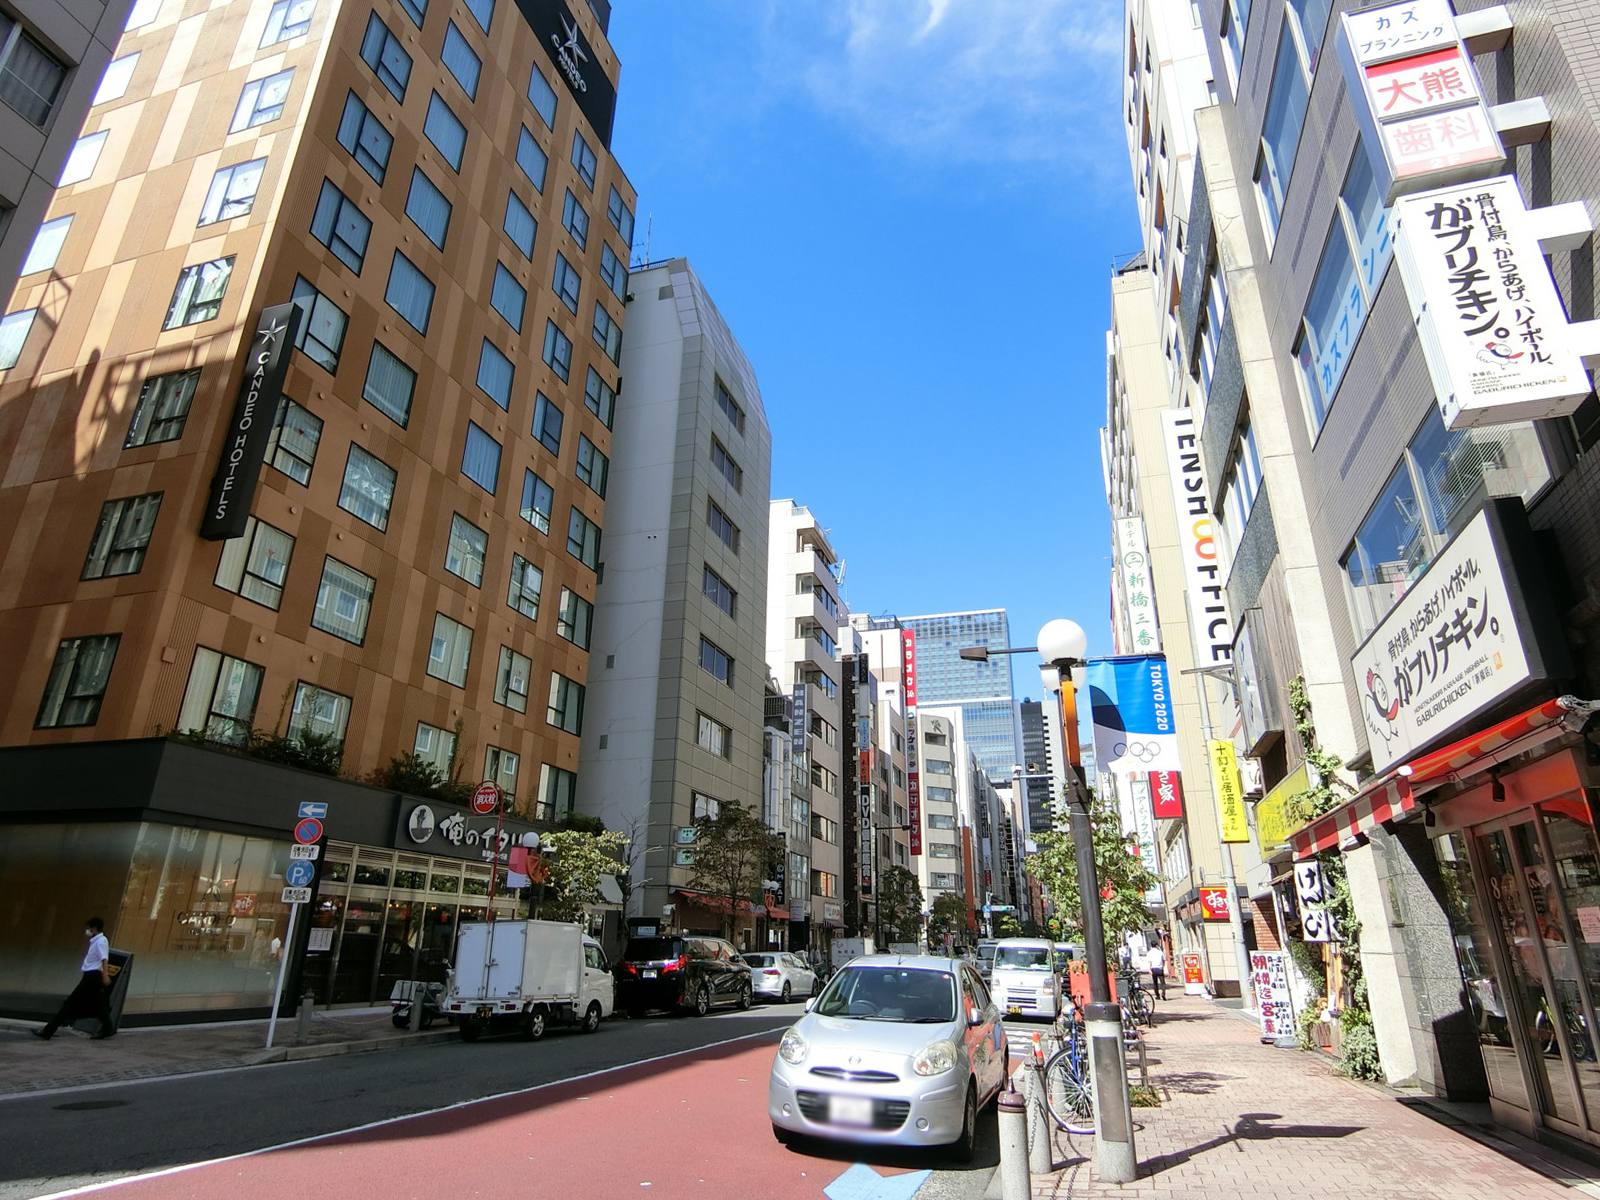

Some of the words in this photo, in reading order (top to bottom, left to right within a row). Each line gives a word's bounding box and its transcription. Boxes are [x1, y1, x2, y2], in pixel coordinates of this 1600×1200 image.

[1376, 8, 1419, 31] カズ
[550, 33, 588, 93] CANDEO
[1377, 66, 1467, 112] 大熊
[1393, 111, 1481, 157] 歯科
[239, 351, 271, 431] CANDEO
[215, 434, 248, 520] HOTELS
[1125, 520, 1137, 548] ホテル
[1128, 572, 1155, 653] 新橋三番
[1149, 664, 1165, 701] TOKYO
[1416, 679, 1473, 727] GABURICHICKEN
[1154, 702, 1169, 731] 2020
[476, 793, 496, 805] 消火栓
[292, 867, 304, 884] P
[1297, 867, 1323, 939] けんび
